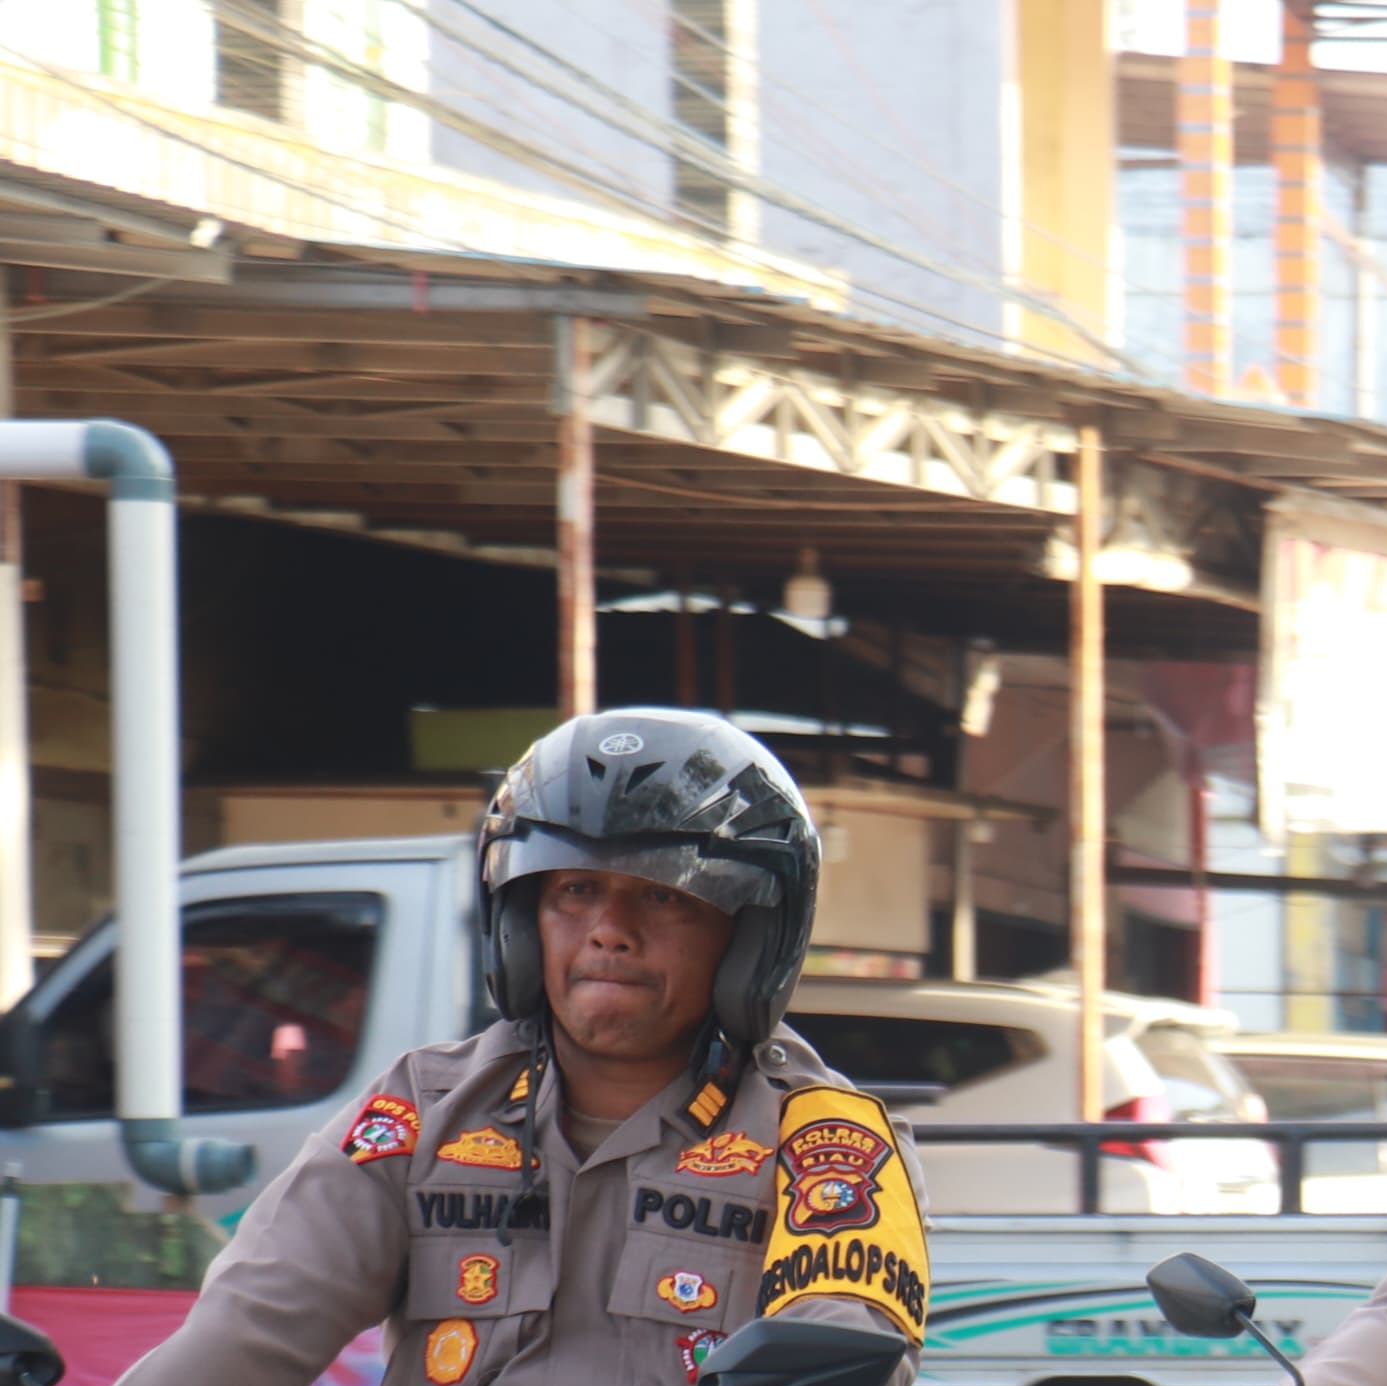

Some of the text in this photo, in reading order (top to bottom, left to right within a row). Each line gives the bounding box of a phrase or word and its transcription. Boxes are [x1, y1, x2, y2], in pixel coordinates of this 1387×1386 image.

[373, 1099, 405, 1118] OPS
[792, 1127, 876, 1155] POLRES
[801, 1153, 864, 1168] RIAU
[632, 1187, 769, 1245] POLRI
